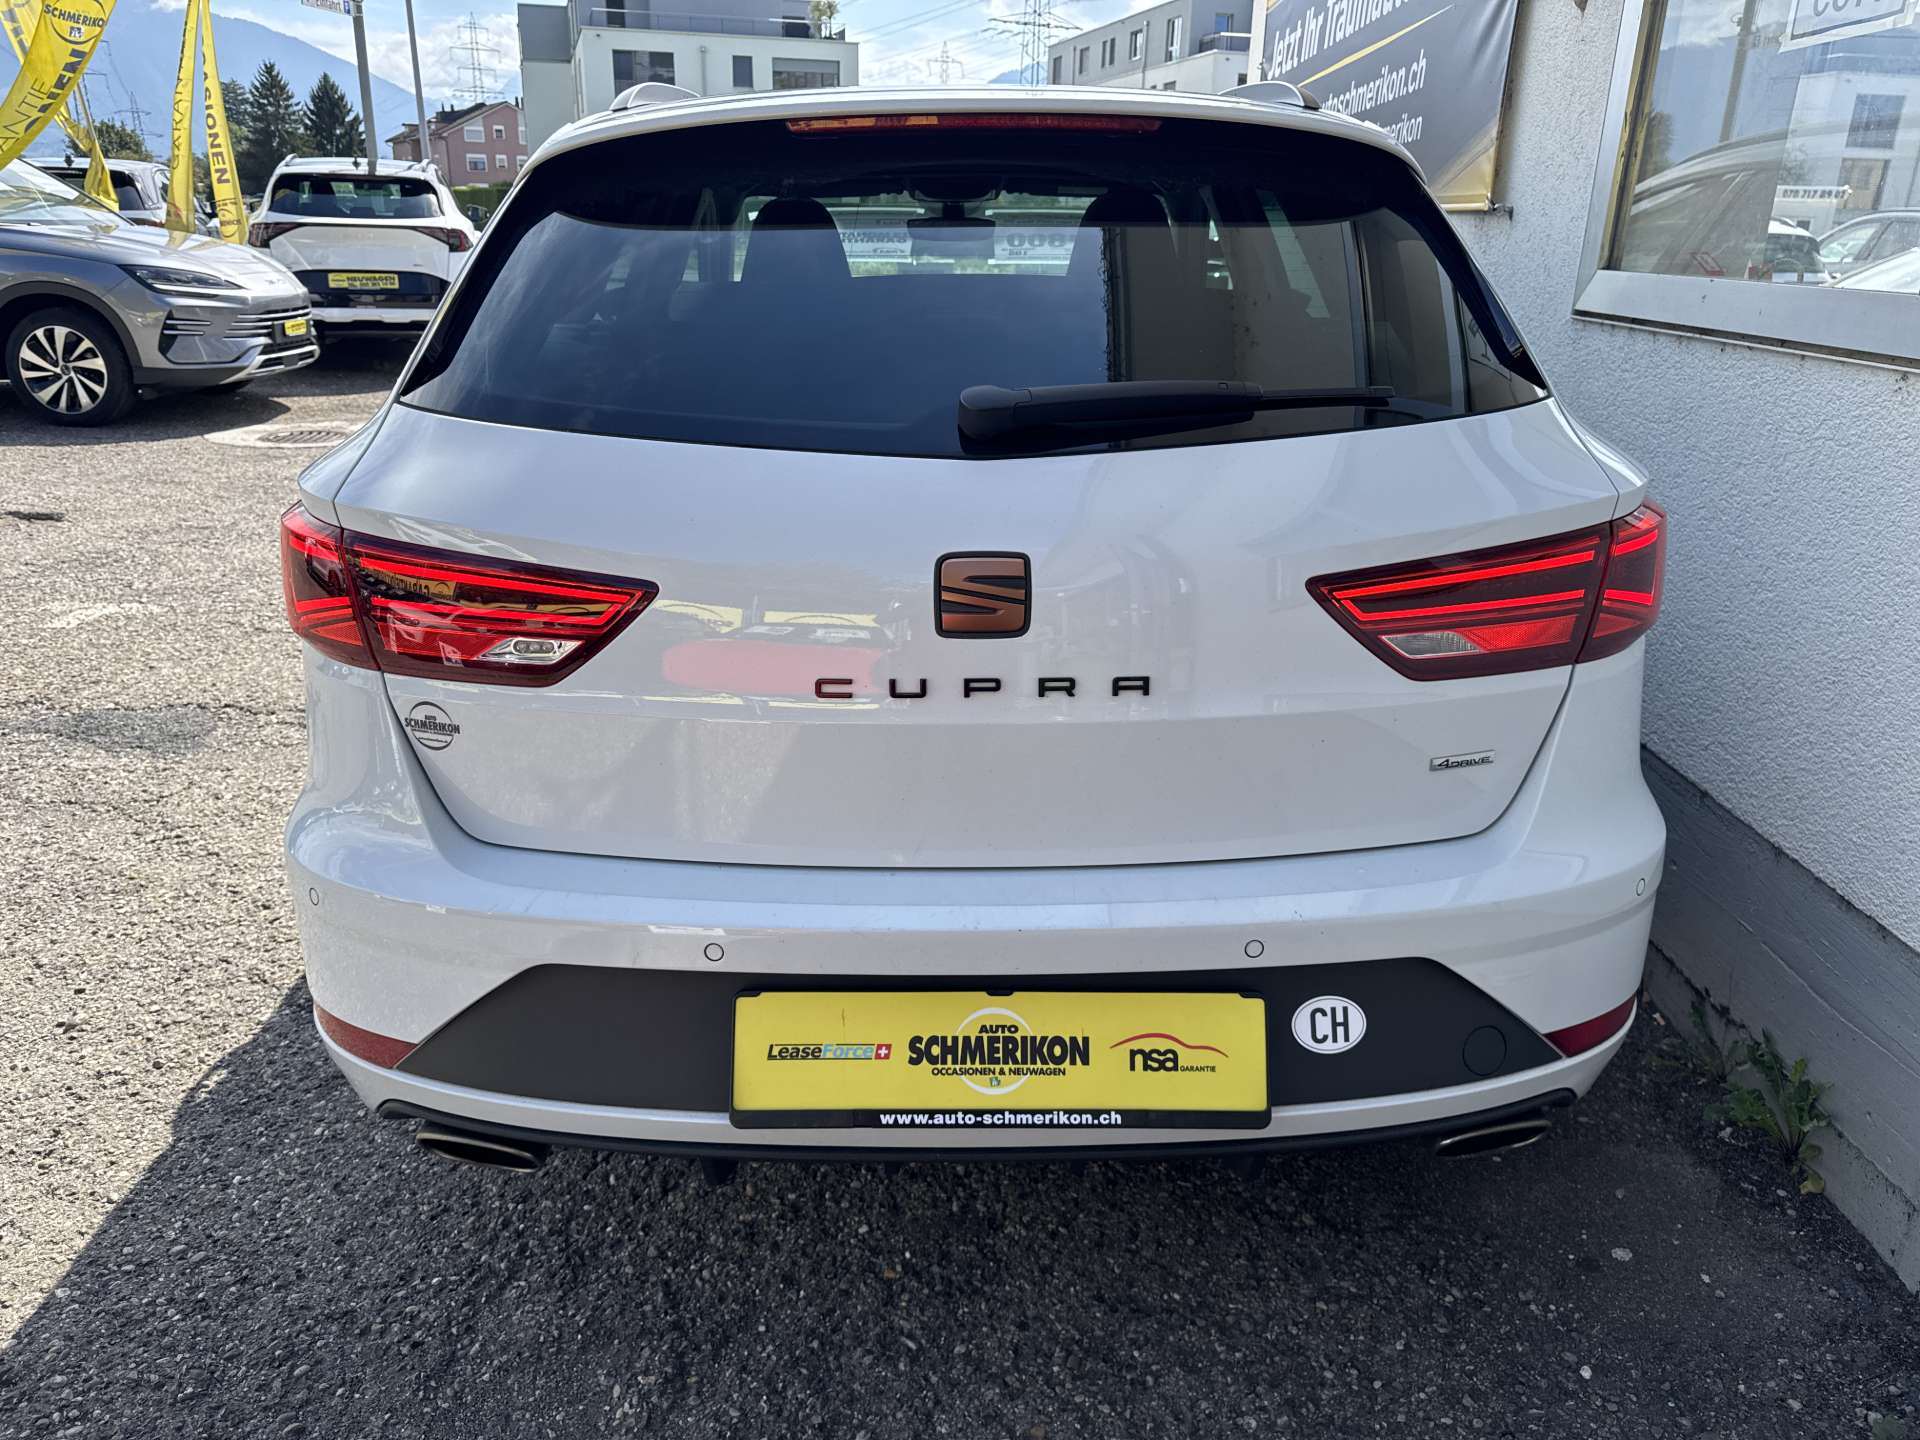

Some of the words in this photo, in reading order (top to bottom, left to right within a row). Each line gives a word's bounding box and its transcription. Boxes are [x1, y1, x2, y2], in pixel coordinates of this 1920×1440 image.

[44, 4, 107, 28] SCHMERIKO
[1267, 20, 1302, 80] Jetzt
[1300, 6, 1324, 62] Ihr
[1323, 0, 1408, 49] Traumau
[814, 676, 1150, 699] CUPRA
[404, 717, 460, 734] SCHMERIKON
[978, 1024, 1019, 1034] AUTO
[1310, 1006, 1350, 1044] CH
[767, 1043, 875, 1060] LeaseForce
[908, 1035, 1090, 1066] SCHMERIKON
[1129, 1048, 1179, 1072] nsa
[1180, 1065, 1217, 1073] GARANTIE
[931, 1067, 996, 1076] OCCASIONEN
[998, 1067, 1006, 1076] &
[1009, 1067, 1066, 1076] NEUWAGEN
[879, 1110, 1122, 1125] www.auto-schmerikon.ch
